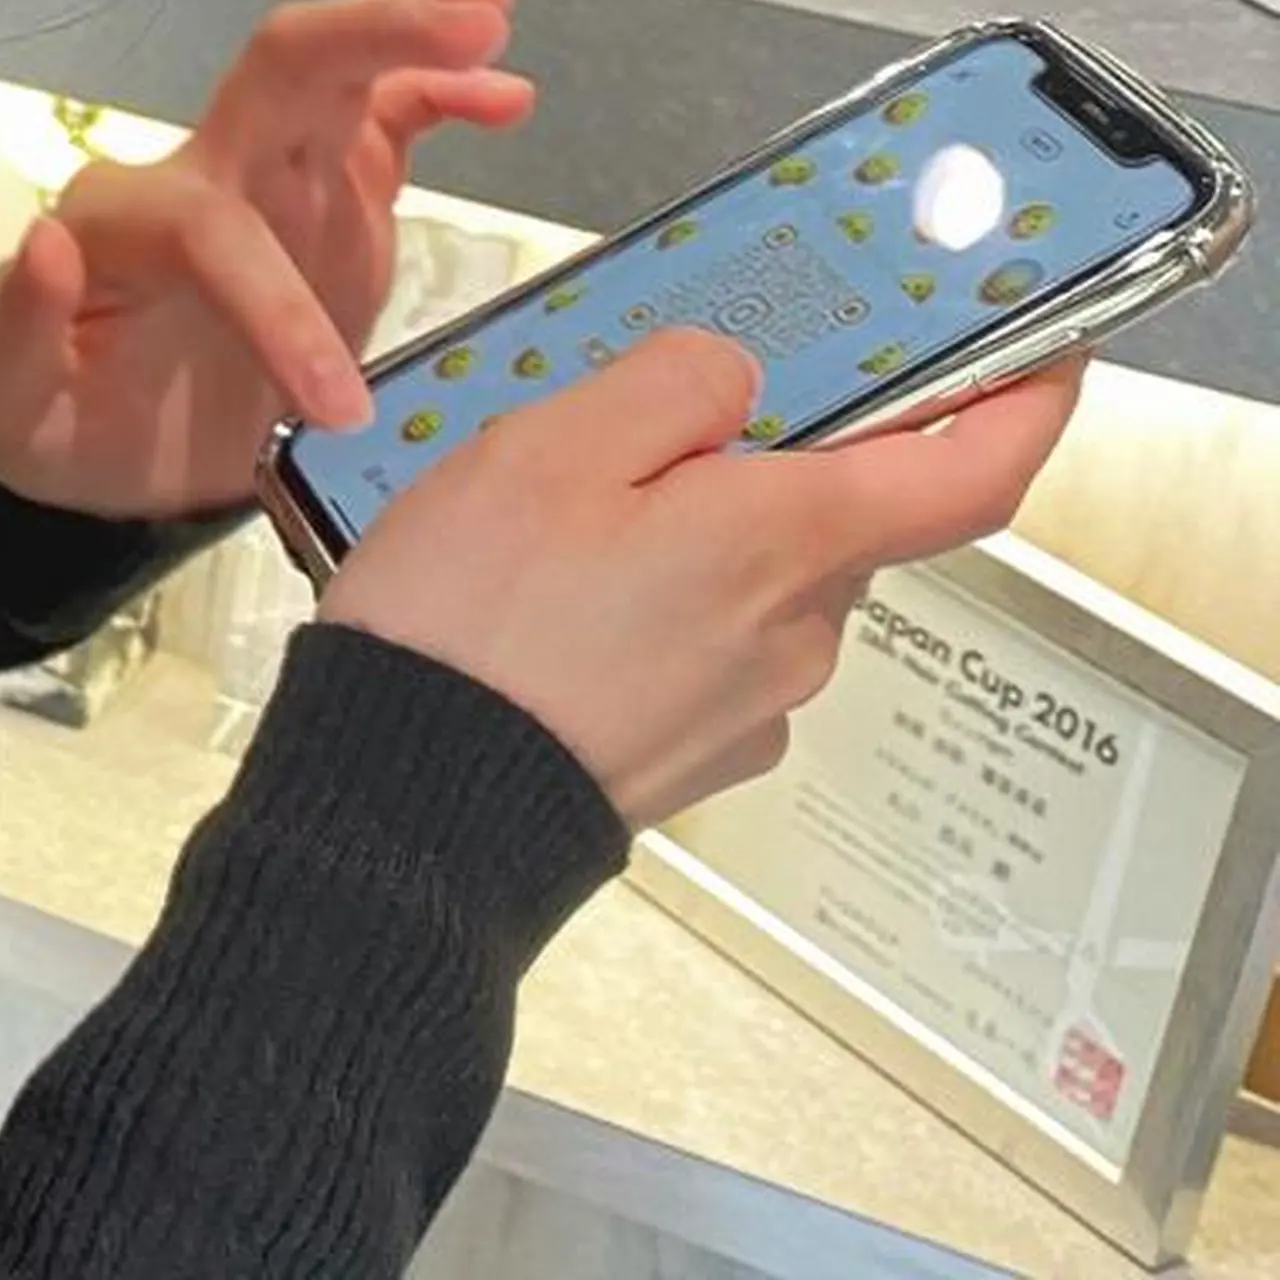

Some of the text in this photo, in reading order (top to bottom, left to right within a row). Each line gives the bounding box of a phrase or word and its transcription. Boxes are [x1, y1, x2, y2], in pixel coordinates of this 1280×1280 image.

[854, 598, 953, 666] apan
[959, 649, 1025, 711] Cup
[1030, 690, 1120, 767] 2016
